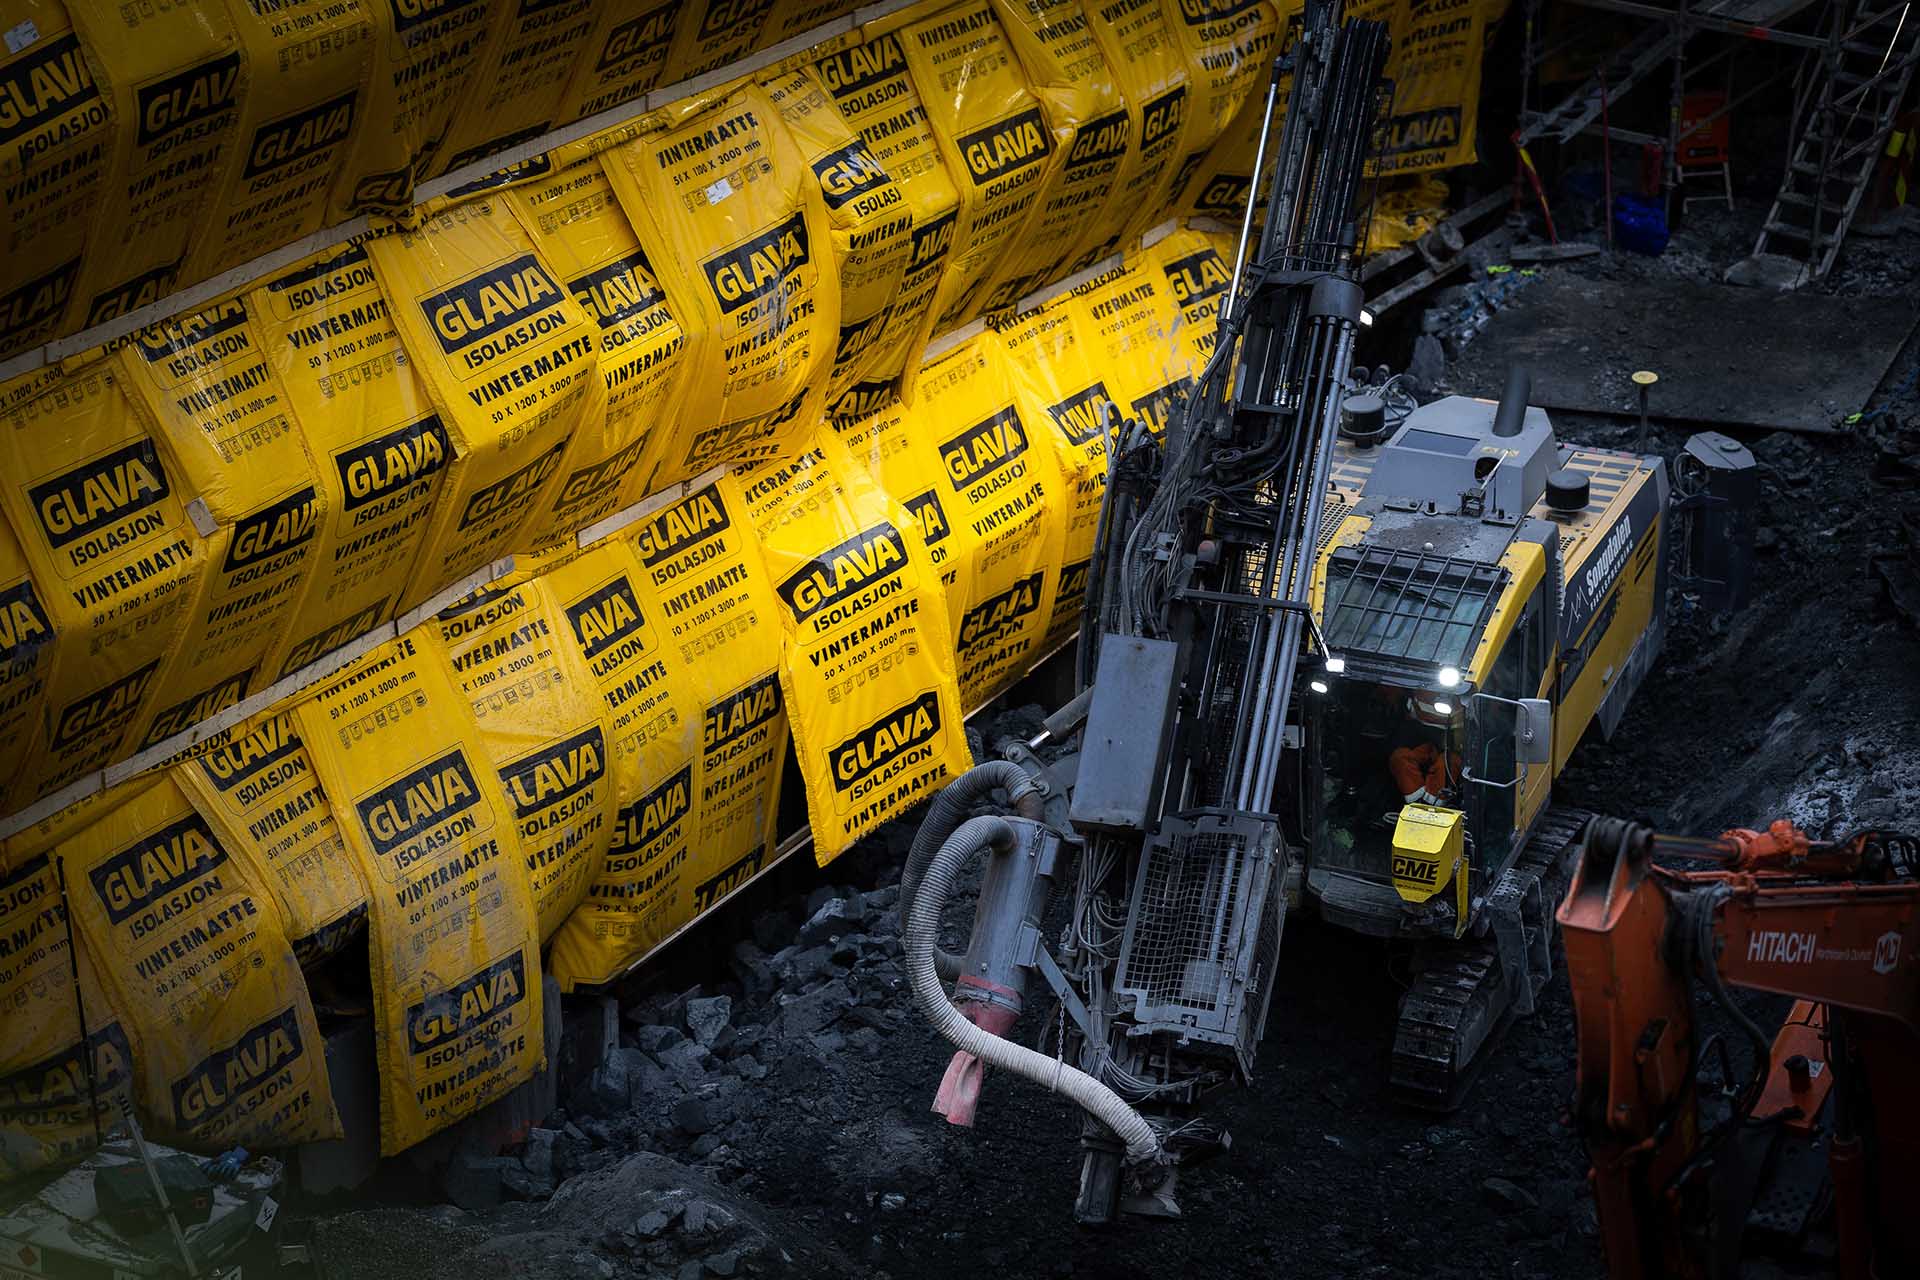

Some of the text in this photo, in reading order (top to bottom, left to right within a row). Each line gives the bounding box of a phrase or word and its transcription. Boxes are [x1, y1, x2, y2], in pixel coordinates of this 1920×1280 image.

[821, 34, 902, 93] GLAVA
[839, 79, 908, 118] ISOLASJON
[657, 110, 759, 169] VINTERMATTE
[967, 120, 1045, 176] GLAVA
[287, 265, 375, 313] ISOLASJON
[713, 230, 804, 302] GLAVA
[433, 265, 556, 343] GLAVA
[601, 306, 673, 354] ISOLASJON
[168, 331, 250, 379] ISOLASJON
[308, 329, 398, 370] 50 X 1200 X 3000 mm
[463, 309, 566, 370] ISOLASJON
[748, 351, 771, 369] 1200
[468, 334, 593, 408] VINTERMATTE
[491, 367, 589, 424] 50 X 1200 X 3000 mm
[346, 431, 444, 500] GLAVA
[944, 415, 1023, 481] GLAVA
[40, 456, 162, 537] GLAVA
[353, 479, 431, 528] ISOLASJON
[637, 492, 722, 559] GLAVA
[69, 509, 165, 568] ISOLASJON
[650, 537, 727, 587] ISOLASJON
[1586, 514, 1632, 597] Songdalen
[72, 538, 193, 609] VINTERMATTE
[792, 534, 902, 614] GLAVA
[93, 612, 106, 628] 50
[108, 607, 115, 620] X
[119, 597, 141, 616] 1200
[143, 592, 151, 605] X
[153, 580, 177, 601] 3000
[809, 598, 919, 667] VINTERMATTE
[812, 576, 903, 634] ISOLASJON
[462, 646, 553, 693] X 1200 X 3000 mm
[824, 626, 917, 681] 50 X 1200 X 3000 mm
[350, 694, 368, 713] 1200
[370, 689, 377, 702] X
[378, 677, 399, 697] 3000
[400, 669, 417, 684] mm
[631, 709, 638, 721] X
[638, 696, 655, 716] 3000
[655, 689, 670, 702] mm
[207, 718, 300, 780] GLAVA
[837, 706, 934, 781] GLAVA
[235, 754, 307, 808] ISOLASJON
[843, 764, 948, 834] VINTERMATTE
[849, 745, 933, 802] ISOLASJON
[368, 765, 473, 842] GLAVA
[103, 828, 218, 913] GLAVA
[395, 813, 477, 869] ISOLASJON
[606, 824, 682, 873] ISOLASJON
[1393, 858, 1440, 880] CME
[396, 838, 499, 908] VINTERMATTE
[130, 876, 223, 941] ISOLASJON
[135, 896, 257, 980] VINTERMATTE
[210, 941, 236, 965] 3000
[237, 929, 257, 947] mm
[1746, 930, 1816, 964] HITACHI
[413, 967, 520, 1044] GLAVA
[181, 1026, 296, 1121] GLAVA
[416, 1034, 525, 1105] VINTERMATTE
[424, 1106, 437, 1120] 50
[481, 1072, 502, 1092] 3000
